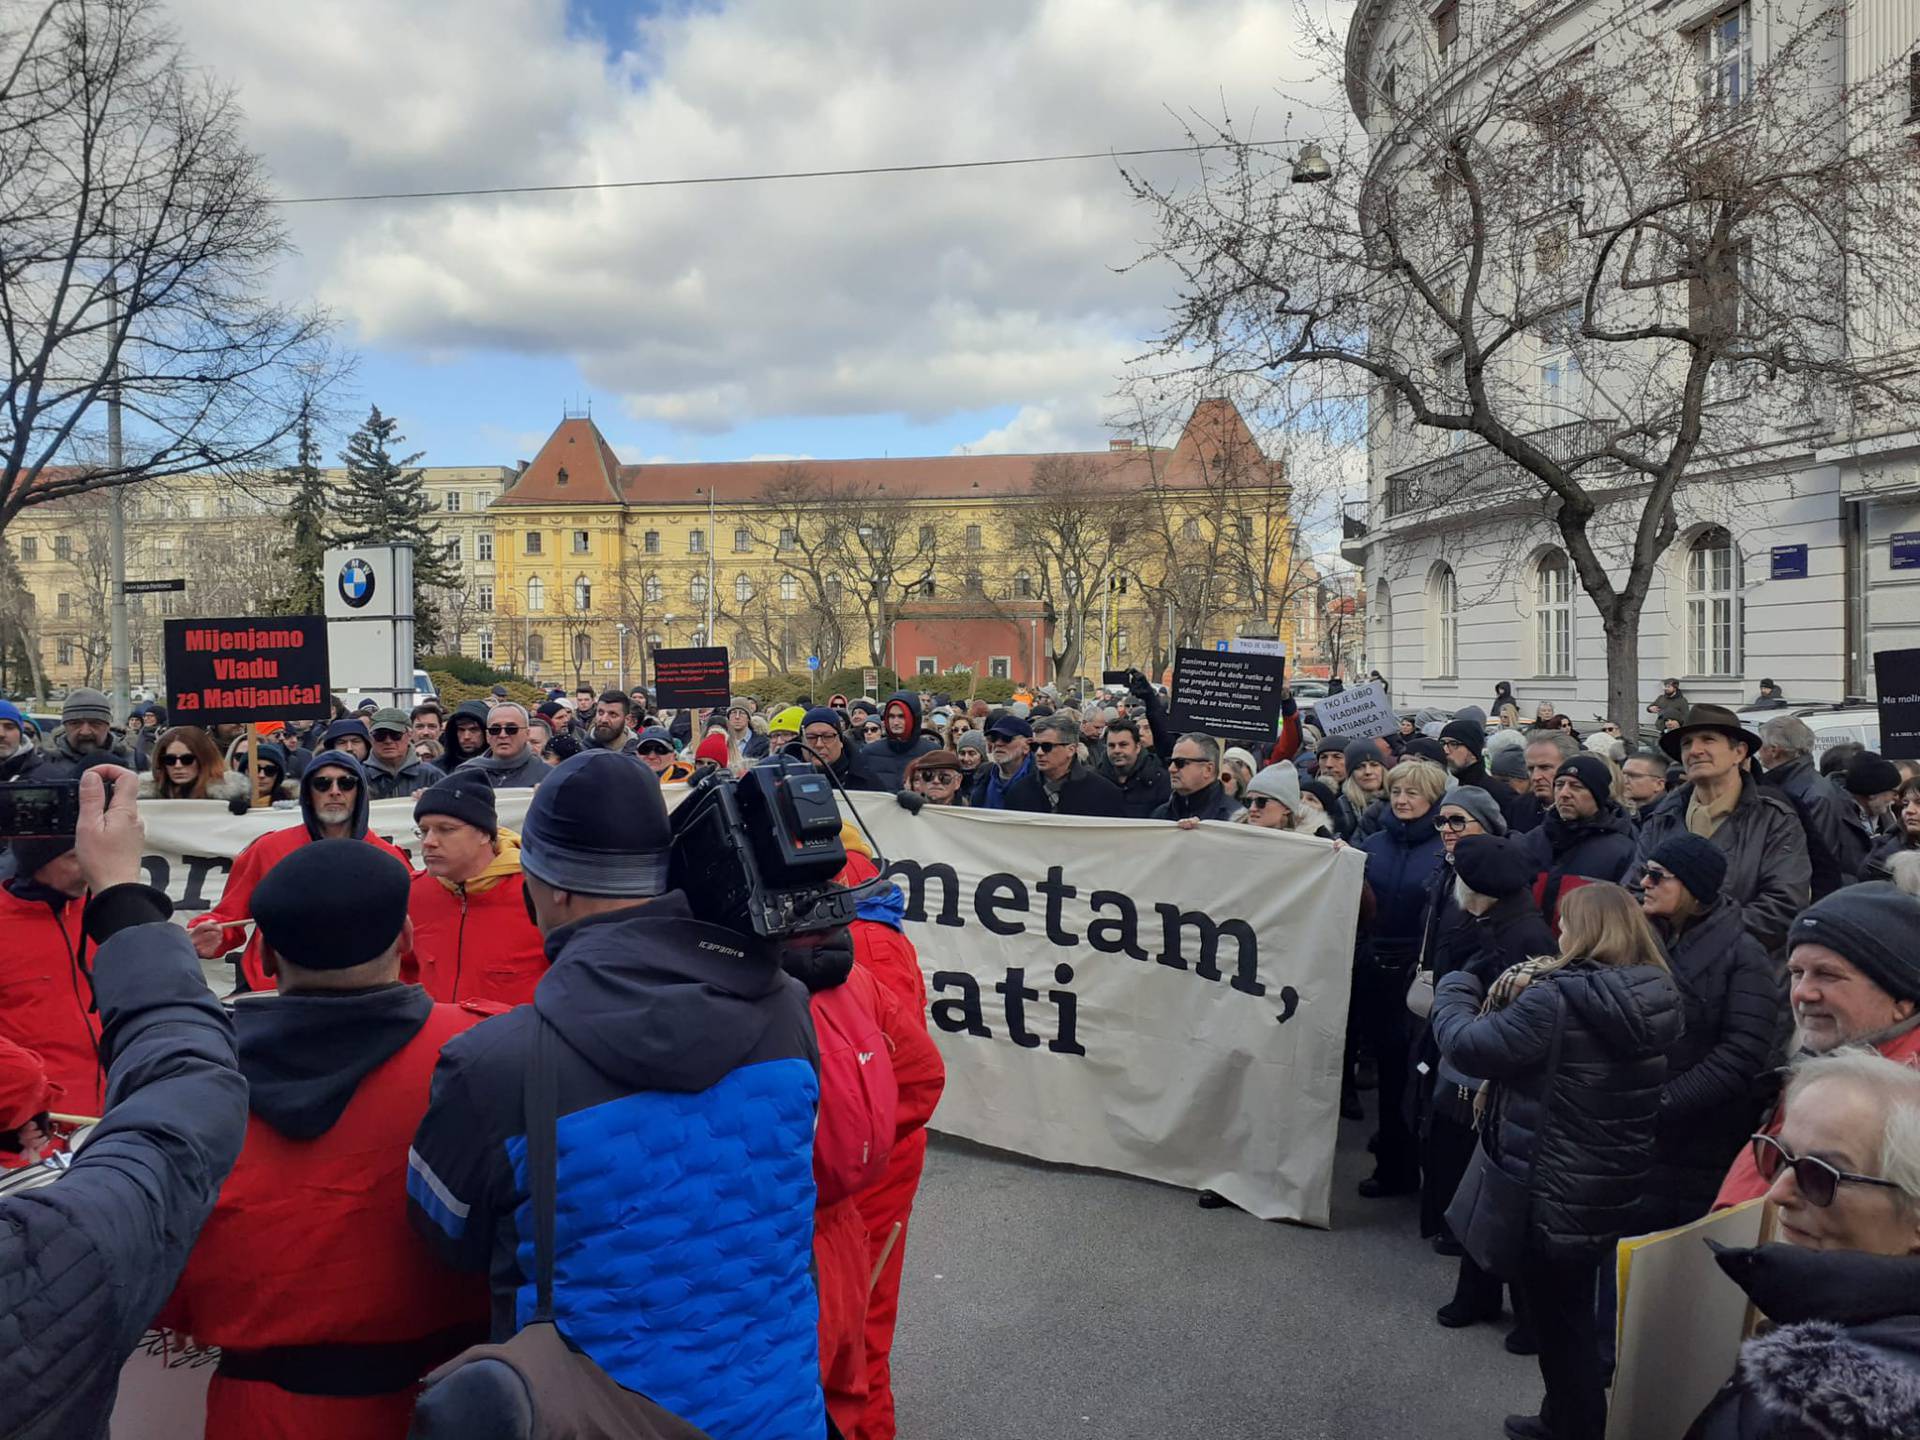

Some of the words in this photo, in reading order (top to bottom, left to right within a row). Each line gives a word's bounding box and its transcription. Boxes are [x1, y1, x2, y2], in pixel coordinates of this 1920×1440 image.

[340, 559, 372, 576] BMW
[185, 628, 305, 652] Mijenjamo
[213, 657, 279, 681] Vladu
[1180, 668, 1217, 676] mogućnost
[1181, 658, 1207, 666] Zanima
[1220, 661, 1243, 670] postoji
[1190, 679, 1220, 687] pregleda
[1262, 684, 1272, 692] da
[1203, 689, 1214, 697] jer
[176, 692, 200, 710] za
[203, 684, 321, 709] Matijanića!
[1177, 697, 1198, 706] stanju
[1323, 699, 1340, 710] TKO
[1342, 695, 1350, 704] JE
[1351, 687, 1373, 700] UBIO
[1329, 700, 1377, 721] VLADIMIRA
[871, 856, 1299, 1024] metam,
[931, 963, 1086, 1057] ati
